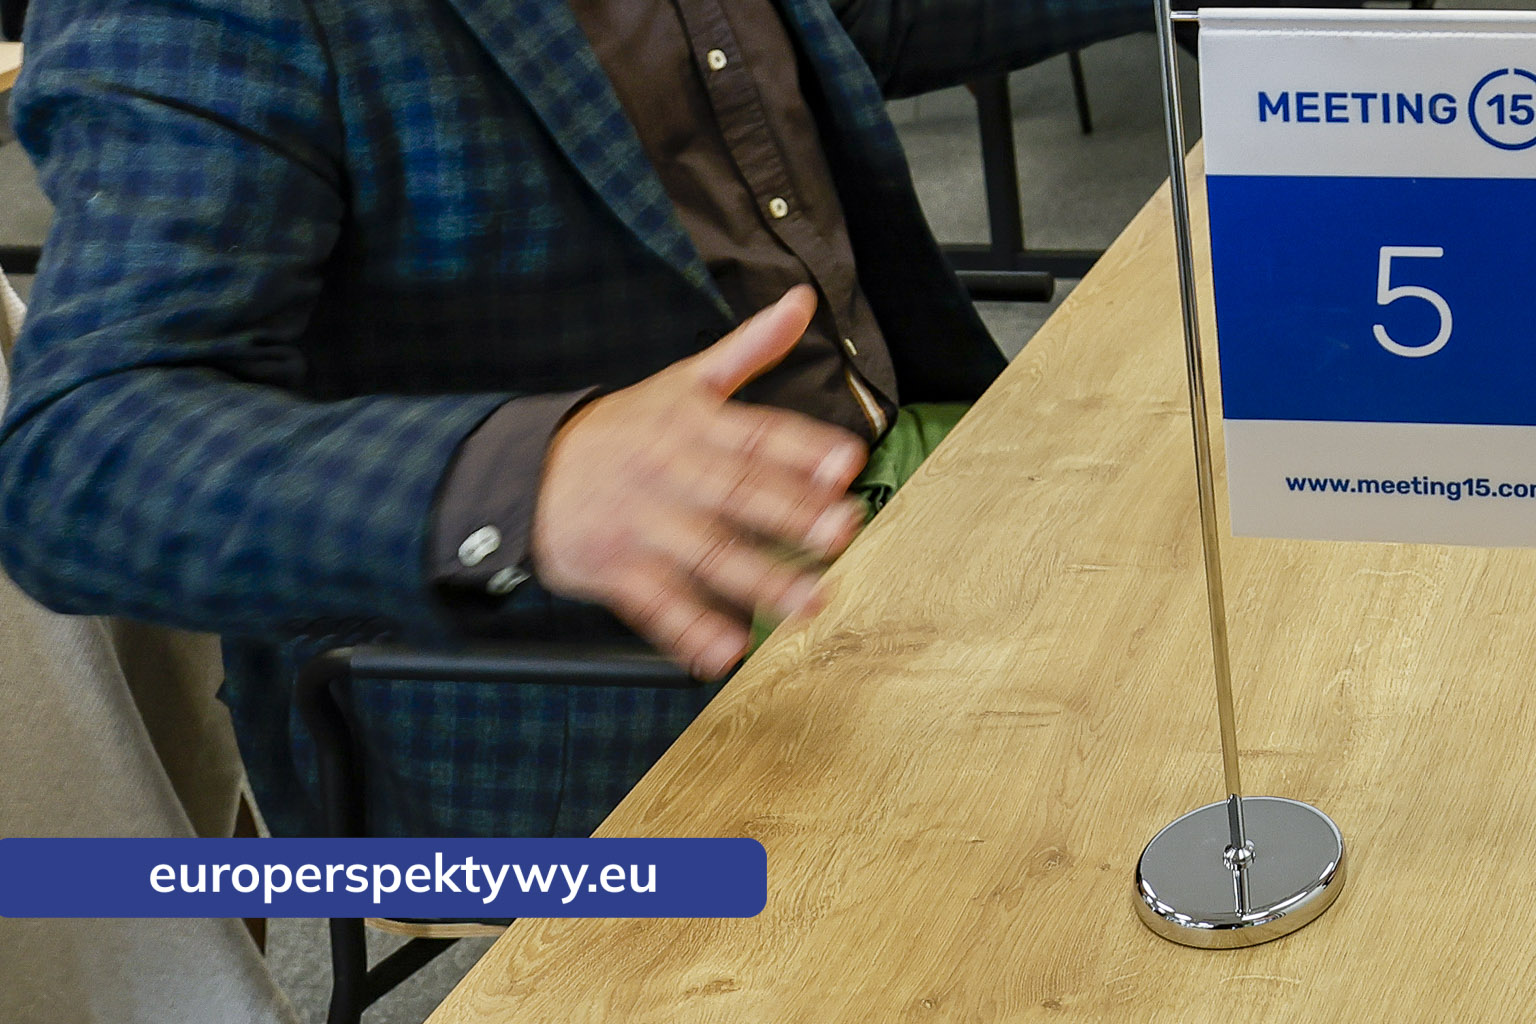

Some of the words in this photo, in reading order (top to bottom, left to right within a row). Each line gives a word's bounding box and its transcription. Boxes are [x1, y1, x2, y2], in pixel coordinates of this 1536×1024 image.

[1257, 91, 1457, 125] MEETING
[1486, 93, 1536, 126] 15
[1373, 246, 1453, 358] 5
